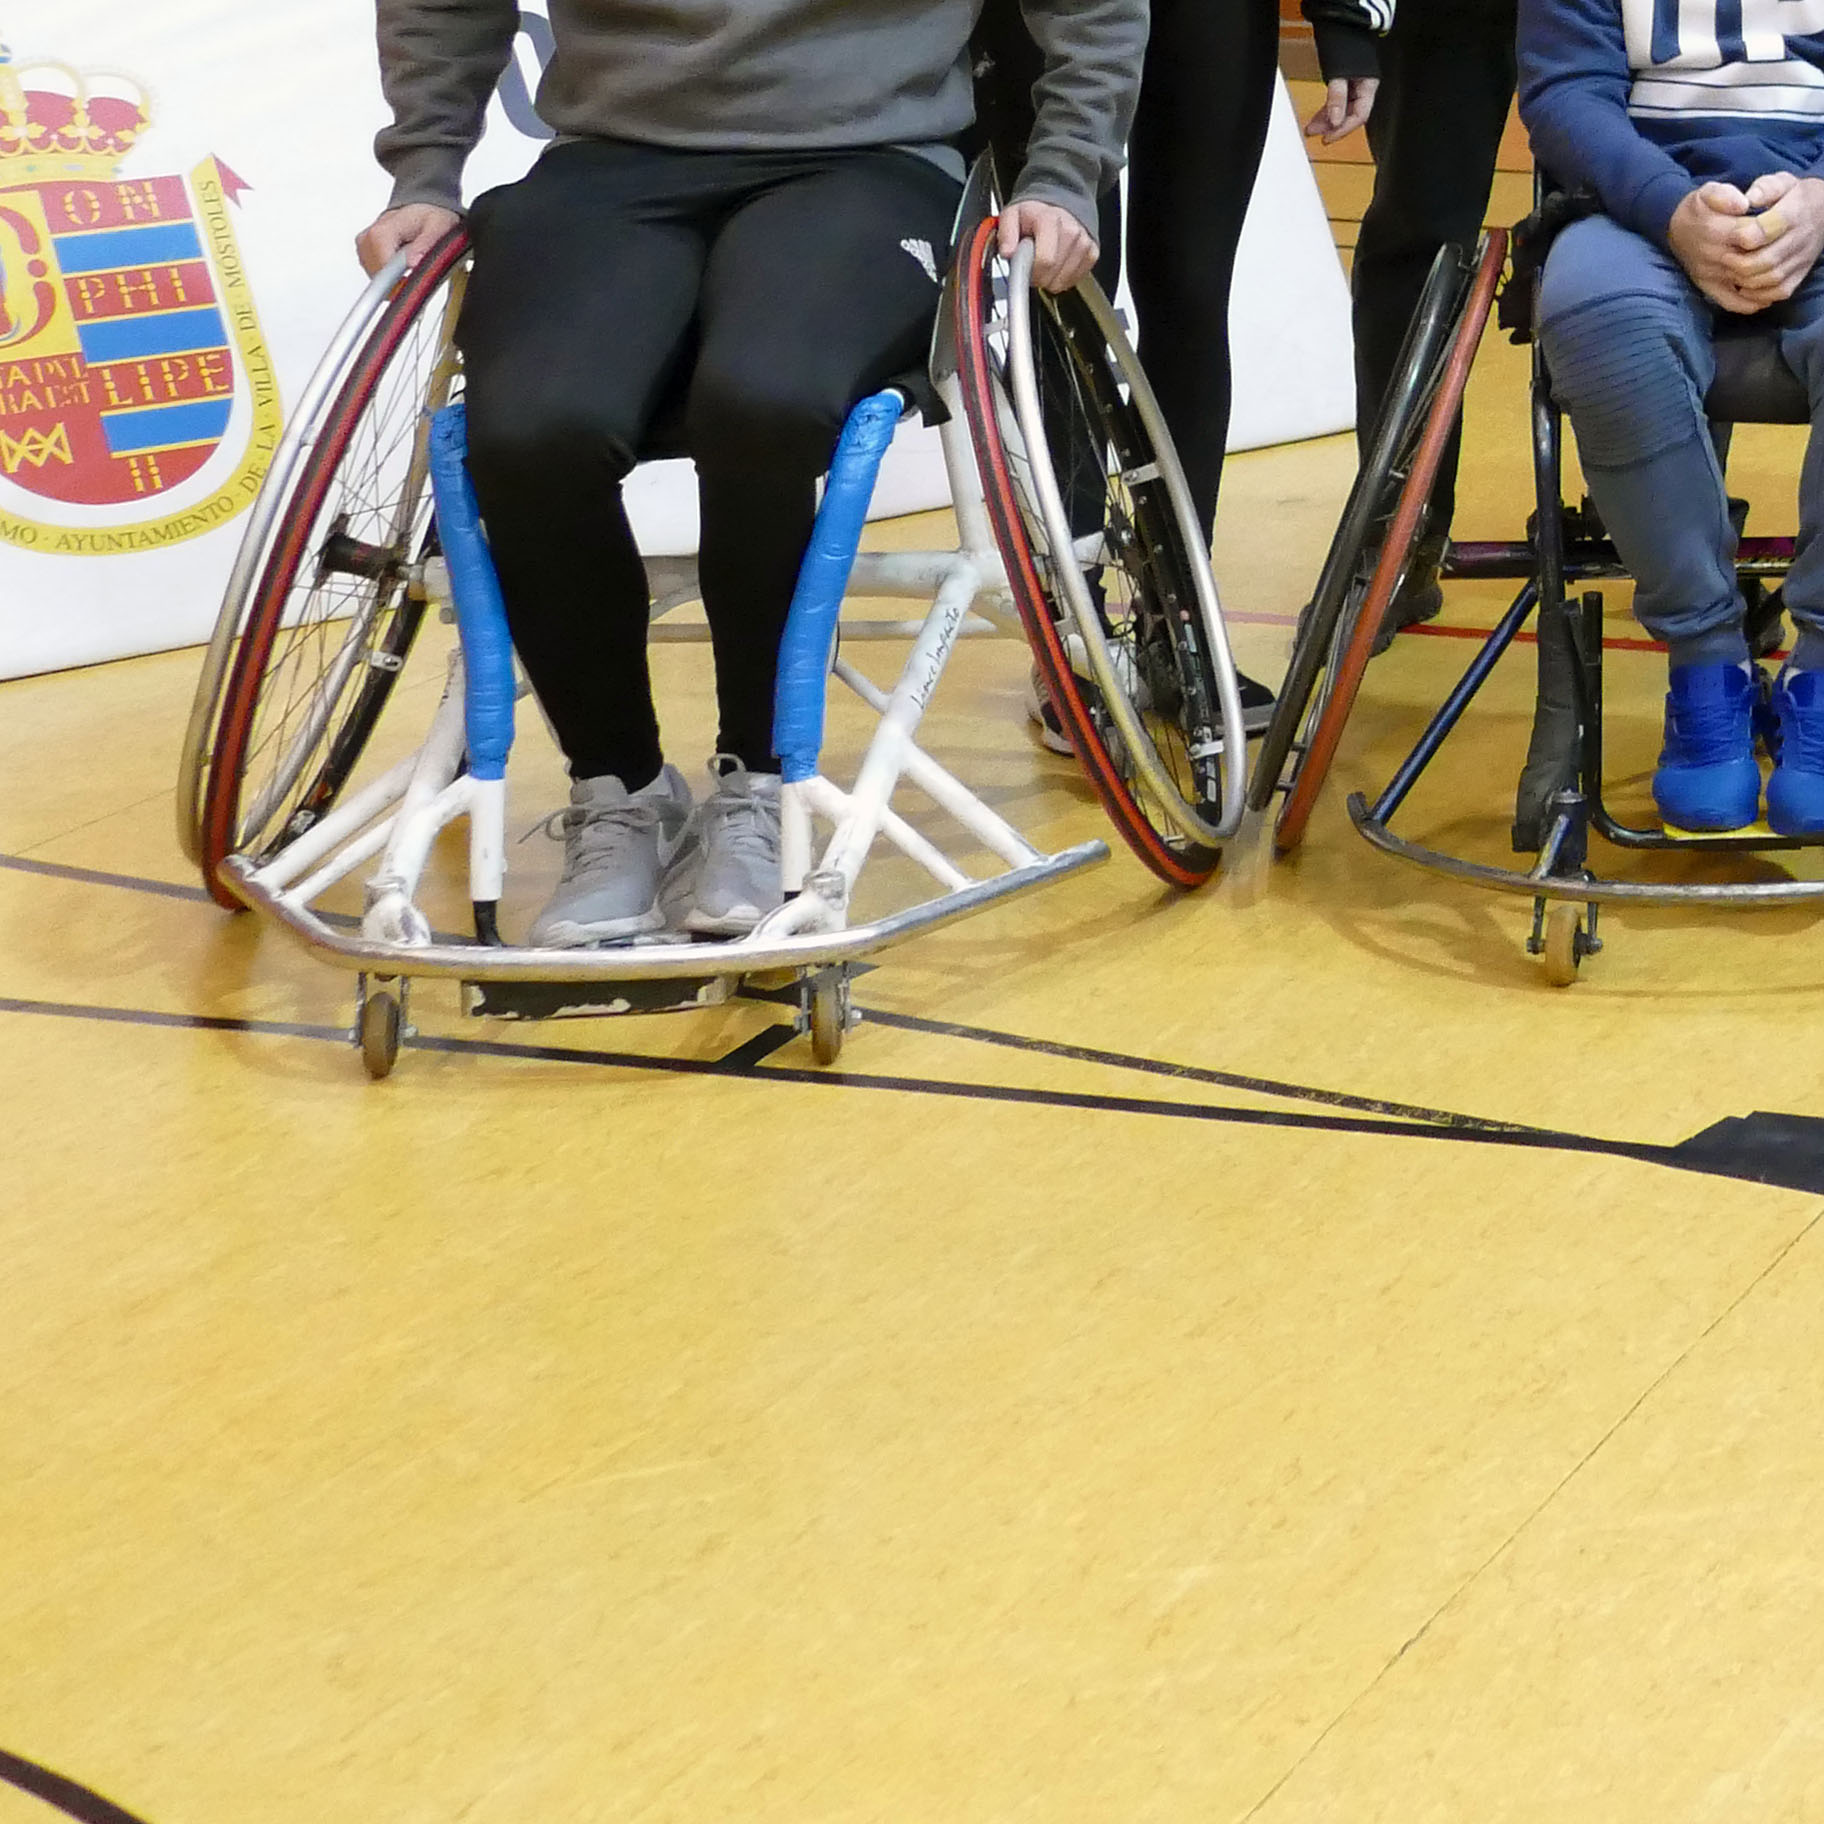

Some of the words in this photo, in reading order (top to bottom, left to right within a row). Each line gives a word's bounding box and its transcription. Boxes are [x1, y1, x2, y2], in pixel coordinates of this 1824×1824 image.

[75, 267, 187, 315] PHI
[234, 306, 257, 331] DE
[102, 353, 230, 407] LIPE
[247, 345, 273, 407] VILLA
[256, 424, 276, 452] LA
[239, 463, 268, 494] DE
[55, 496, 234, 551] AYUNTAMIENTO
